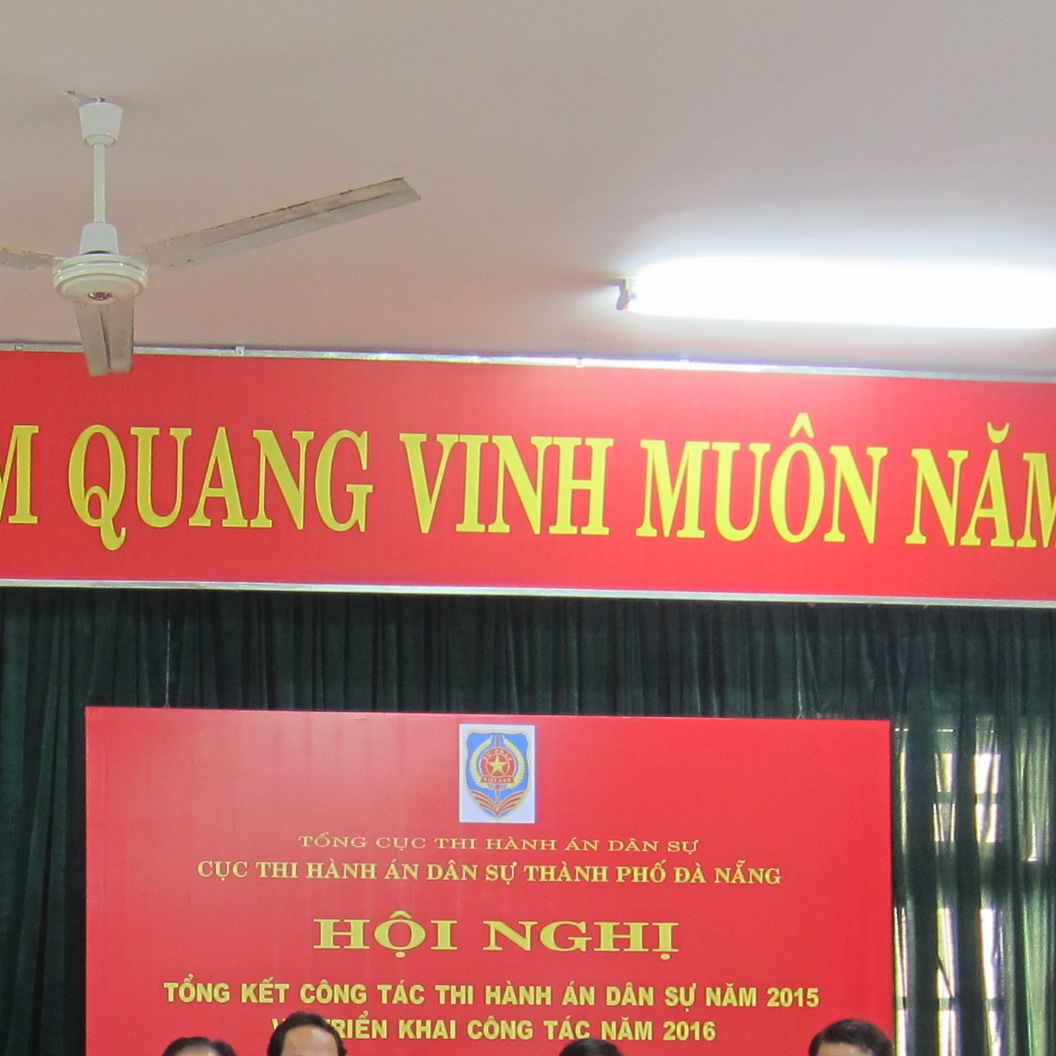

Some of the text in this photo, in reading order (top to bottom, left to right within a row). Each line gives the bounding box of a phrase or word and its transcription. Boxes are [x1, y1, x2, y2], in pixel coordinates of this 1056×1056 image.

[68, 424, 371, 551] QUANG
[398, 432, 614, 536] VINH
[634, 413, 888, 544] MUÔN
[298, 832, 699, 855] TỔNG CỤC THI HÀNH ÁN DÂN SỰ
[197, 858, 782, 885] CỤC THI HÀNH ÁN DÂN SỰ THÀNH PHỐ ĐÀ NẴNG
[313, 909, 679, 961] HỘI NGHỊ
[163, 973, 820, 1012] TỔNG KẾT CÔNG TÁC THI HÀNH ÁN DÂN SỰ NĂM 2015
[398, 1018, 456, 1039] KHAI
[467, 1015, 534, 1040] CÔNG
[543, 1014, 591, 1041] TÁC
[601, 1016, 653, 1041] NĂM
[662, 1021, 717, 1042] 2016
